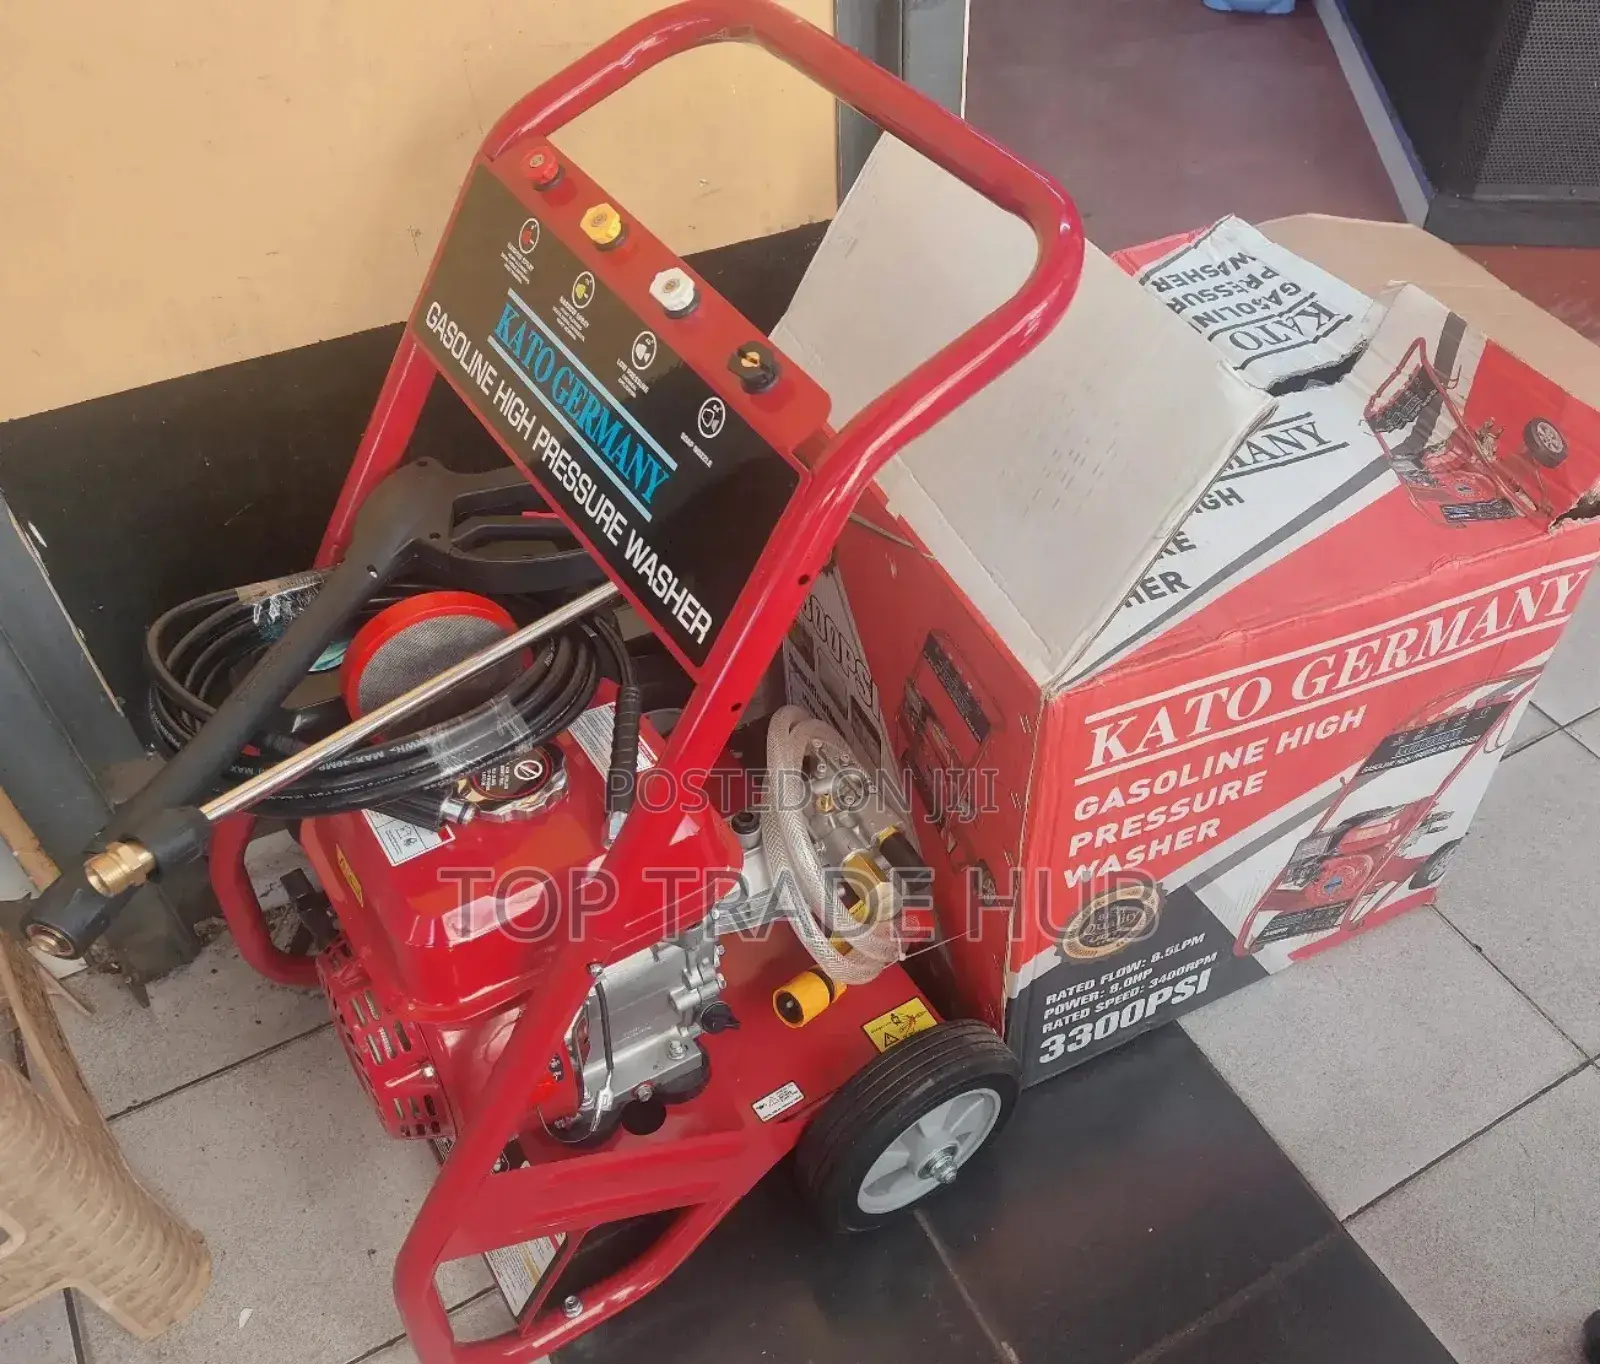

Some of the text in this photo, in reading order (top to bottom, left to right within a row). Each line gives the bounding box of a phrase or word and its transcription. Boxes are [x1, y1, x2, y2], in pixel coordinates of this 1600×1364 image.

[1151, 252, 1256, 293] WASHER
[1189, 282, 1301, 334] GASOLIN
[1229, 300, 1341, 351] KATO
[493, 303, 556, 384] KATO
[552, 366, 670, 504] GERMANY
[425, 301, 498, 396] GASOLINE
[492, 379, 537, 441] HIGH
[532, 424, 628, 547] PRESSURE
[624, 528, 713, 645] WASHER
[1083, 676, 1272, 771] KATO
[1291, 567, 1592, 700] GERMANY
[1074, 737, 1270, 822] GASOLINE
[1274, 703, 1368, 755] HIGH
[1063, 817, 1221, 889] WASHER
[1068, 770, 1268, 858] PRESSURE
[1042, 952, 1218, 1034] RATED SPEED: 3400RPM
[1043, 991, 1105, 1020] POWER:
[1046, 979, 1096, 1006] RATED
[1100, 958, 1147, 985] FLOW:
[1150, 932, 1206, 963] 8.5LPM
[1039, 967, 1213, 1064] 3300PSI
